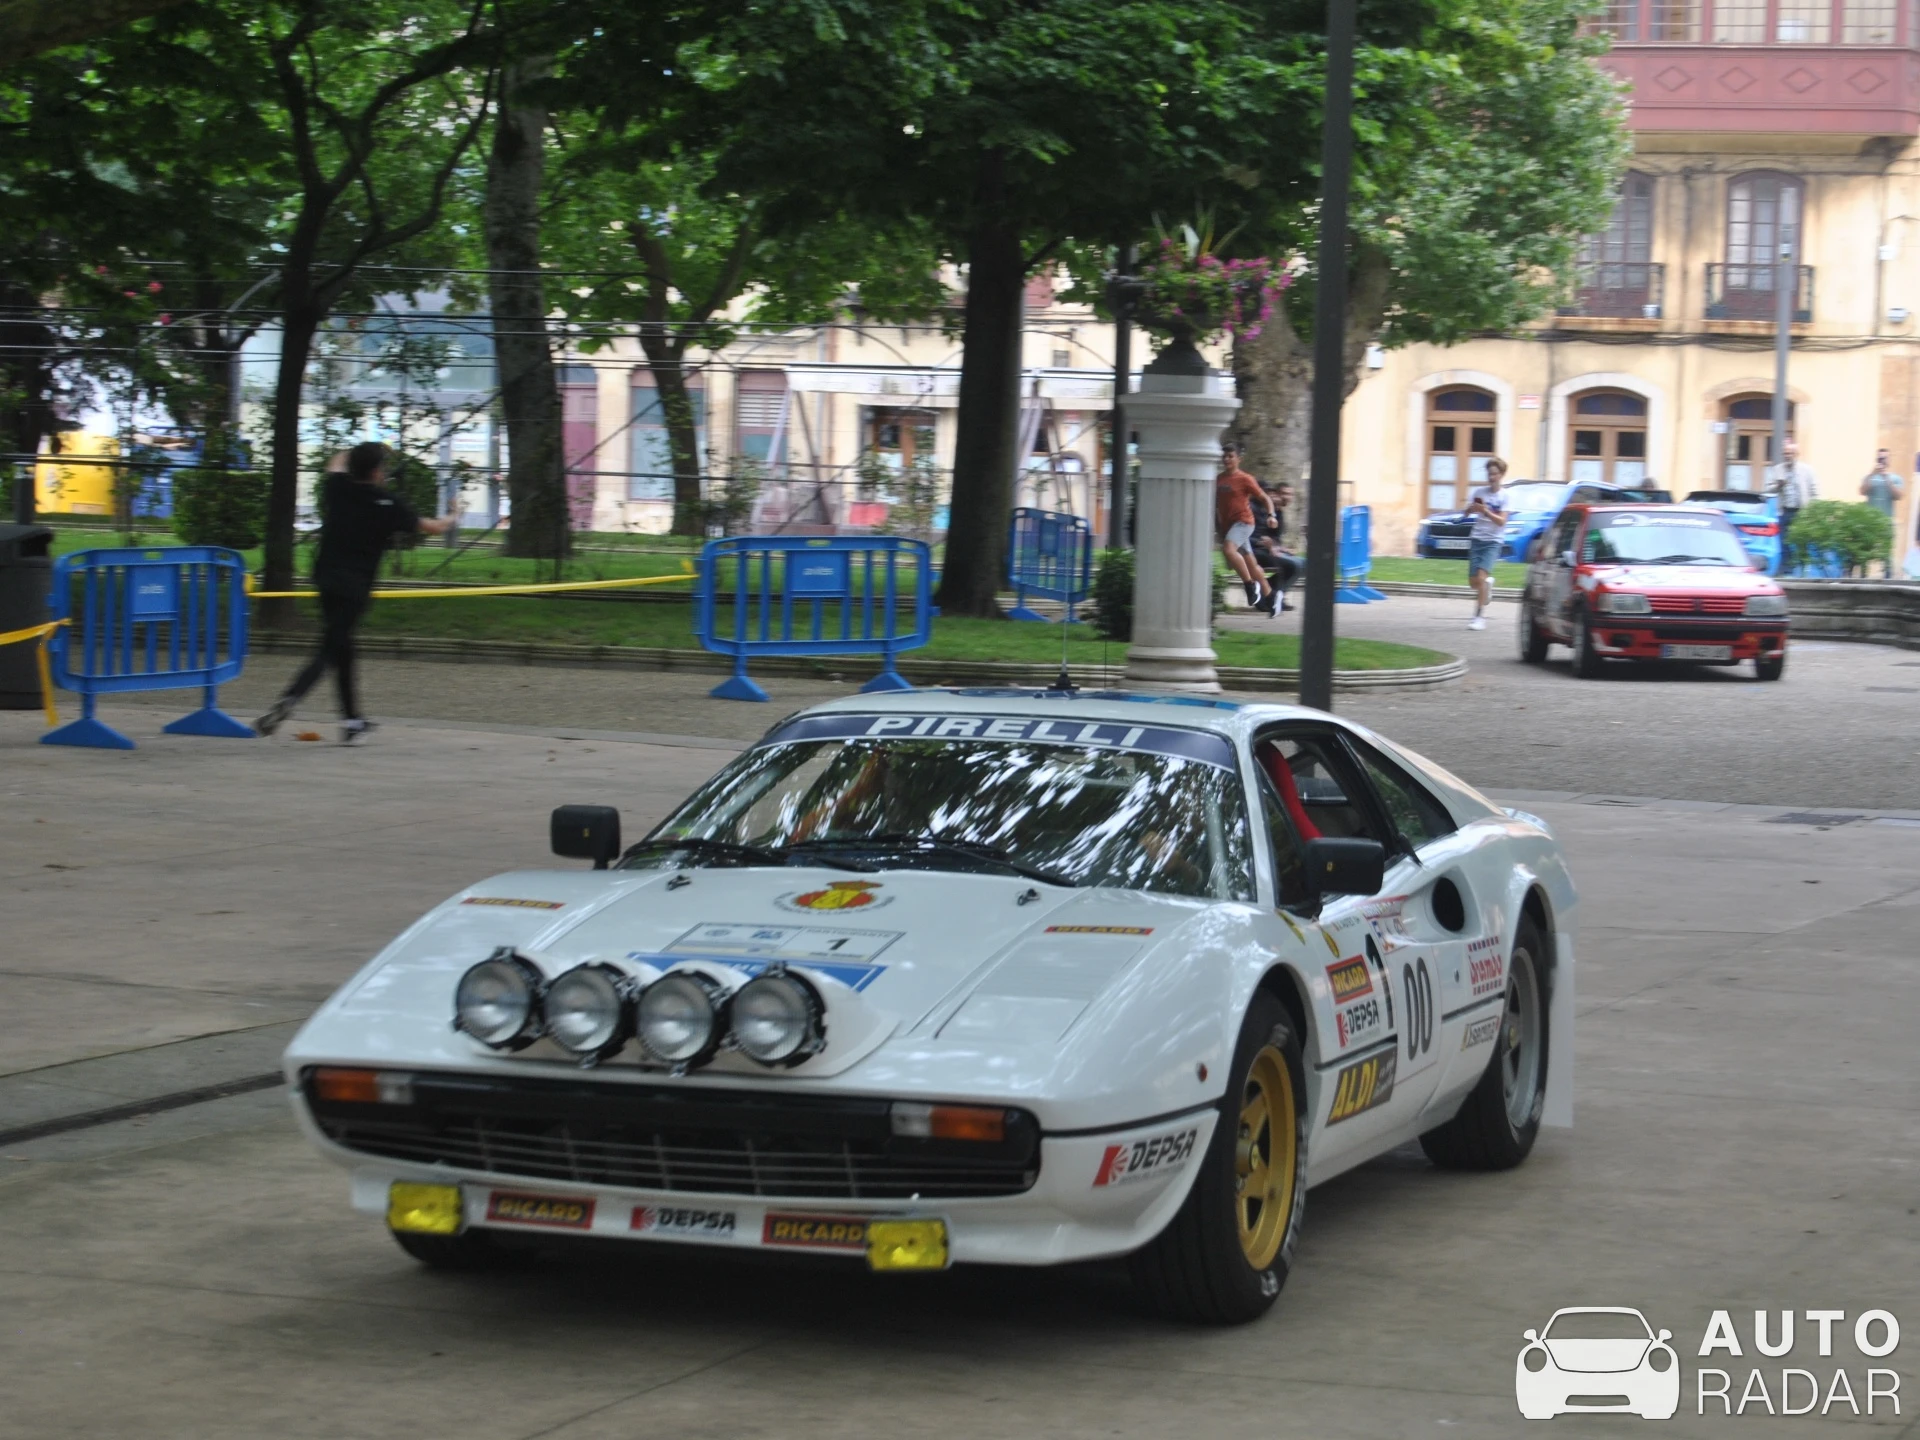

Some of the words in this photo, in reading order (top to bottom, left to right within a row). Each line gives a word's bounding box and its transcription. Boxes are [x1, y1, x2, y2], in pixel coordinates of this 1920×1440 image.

[865, 716, 1145, 748] PIRELLI
[827, 938, 851, 951] 1
[1331, 964, 1367, 996] RICARD
[1468, 948, 1502, 985] brembo
[1346, 999, 1380, 1035] DEPSA
[1403, 956, 1432, 1061] 00
[1328, 1057, 1378, 1121] ALDI
[1127, 1127, 1198, 1173] DEPSA
[498, 1199, 585, 1223] RICARD
[657, 1206, 738, 1230] DEPSA
[774, 1220, 864, 1242] RICARD
